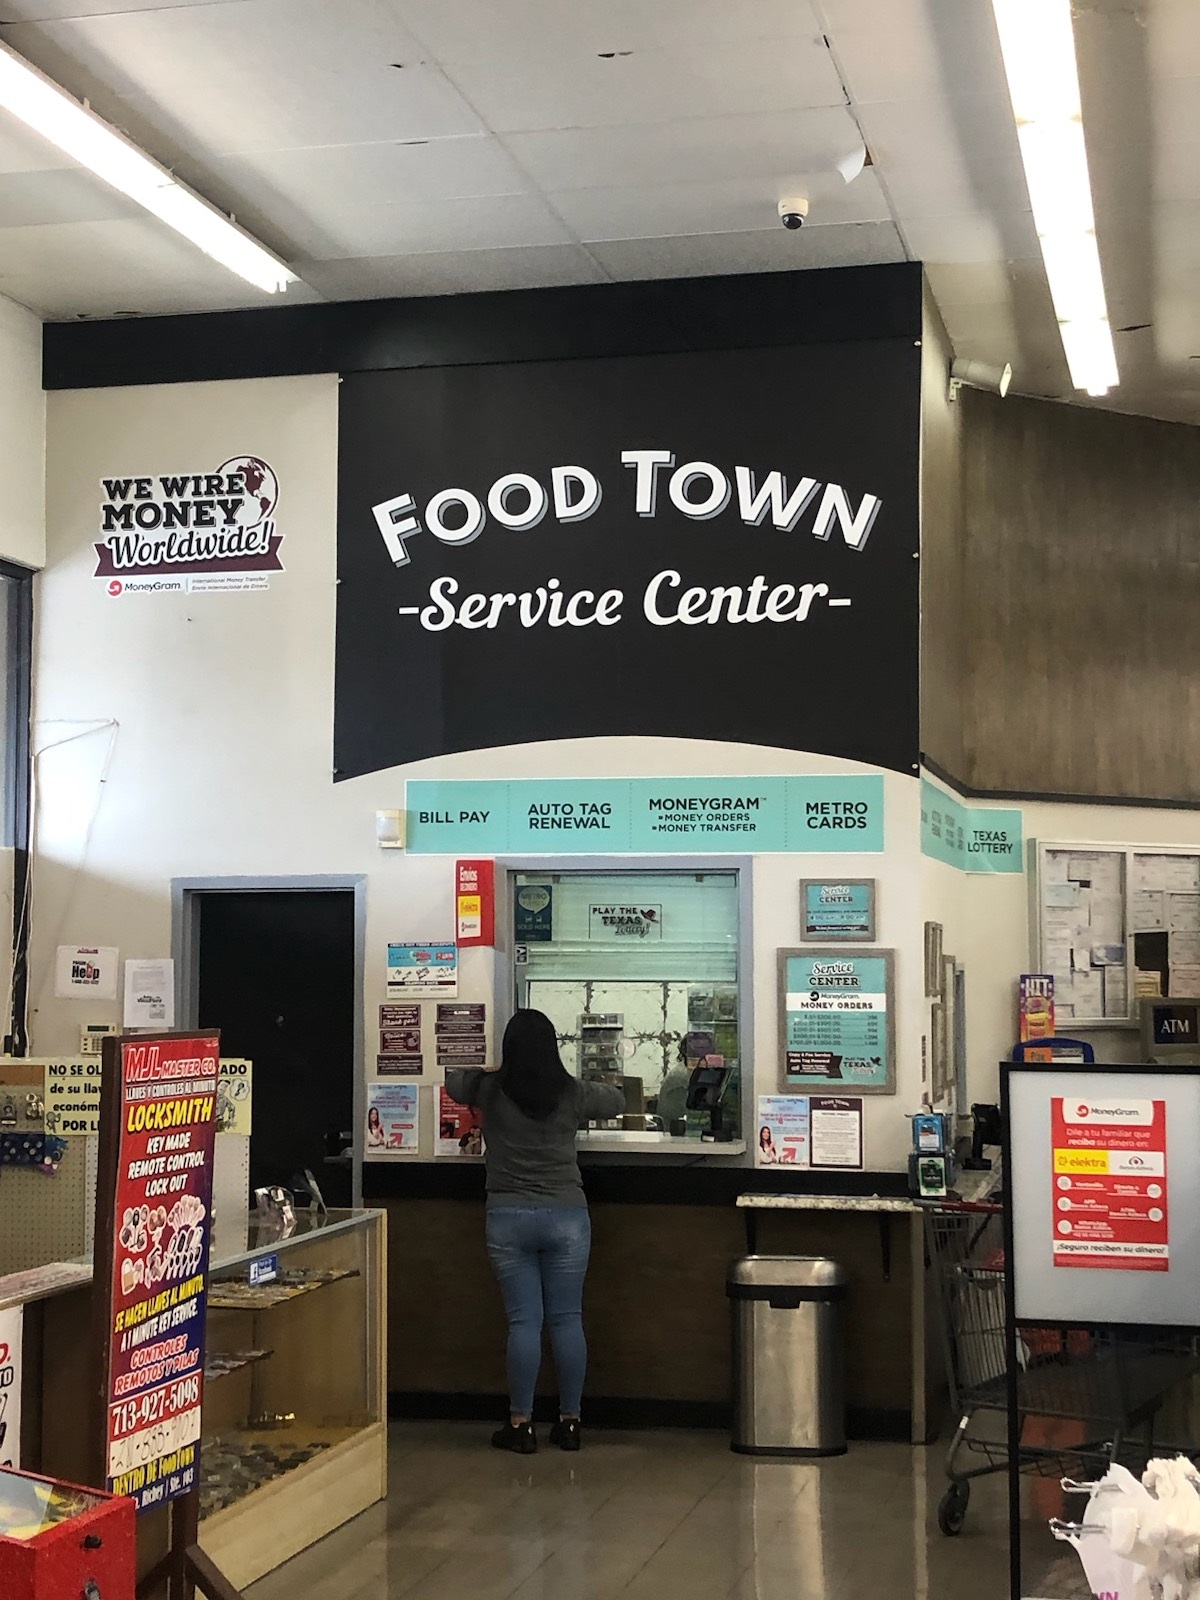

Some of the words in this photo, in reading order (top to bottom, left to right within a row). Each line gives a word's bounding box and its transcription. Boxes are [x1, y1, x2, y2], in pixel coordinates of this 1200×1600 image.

[102, 478, 152, 500] WE
[159, 473, 244, 498] WIRE
[102, 499, 244, 531] MONEY
[372, 466, 602, 567] FOOD
[621, 450, 882, 551] TOWN
[108, 520, 275, 566] Worldwide!
[124, 581, 181, 593] MoneyGram
[528, 803, 574, 816] AUTO
[579, 803, 612, 815] TAG
[806, 801, 868, 815] METRO
[419, 811, 454, 824] BILL
[459, 811, 490, 823] PAY
[529, 817, 611, 829] RENEWAL
[664, 813, 704, 822] MONEY
[706, 813, 750, 822] ORDERS
[807, 816, 867, 829] CARDS
[658, 823, 697, 832] MONEY
[699, 823, 757, 832] TRANSFER
[973, 830, 1008, 842] TEXAS
[967, 842, 1014, 854] LOTTERY
[818, 896, 854, 904] CENTER
[592, 907, 616, 915] PLAY
[619, 907, 638, 915] THE
[601, 915, 644, 926] TEXAS
[72, 962, 100, 980] Help
[812, 961, 854, 975] Service
[809, 976, 859, 986] CENTER
[1025, 978, 1050, 997] HIT
[800, 1001, 834, 1010] MONEY
[837, 1002, 873, 1010] ORDERS
[1160, 1019, 1190, 1034] ATM
[48, 1064, 67, 1075] NO
[70, 1065, 83, 1075] SE
[86, 1064, 103, 1076] OL
[161, 1058, 200, 1080] MASTER
[219, 1064, 247, 1075] ADO
[50, 1083, 64, 1094] de
[67, 1085, 80, 1094] su
[127, 1096, 214, 1133] LOCKSMITH
[1090, 1107, 1140, 1117] MoneyGram
[62, 1120, 87, 1131] POR
[1066, 1128, 1083, 1136] Dile
[1101, 1129, 1133, 1138] familiar
[1133, 1132, 1151, 1140] que
[146, 1134, 165, 1155] KEY
[164, 1131, 191, 1151] MADE
[1108, 1139, 1135, 1147] dinero
[1135, 1140, 1149, 1148] en:
[127, 1155, 165, 1180] REMOTE
[166, 1150, 205, 1172] CONTROL
[1069, 1157, 1107, 1168] elektra
[145, 1177, 169, 1198] LOCK
[169, 1173, 188, 1191] OUT
[1090, 1243, 1121, 1252] reciben
[1134, 1245, 1165, 1255] dinero!
[114, 1310, 125, 1334] SE
[120, 1332, 127, 1353] A
[130, 1333, 188, 1370] CONTROLES
[114, 1362, 167, 1396] REMOTOS
[164, 1357, 174, 1377] Y
[172, 1347, 200, 1374] PILAS
[112, 1375, 199, 1437] 713-927-5098
[113, 1467, 145, 1498] DENTRO
[145, 1461, 158, 1486] DE
